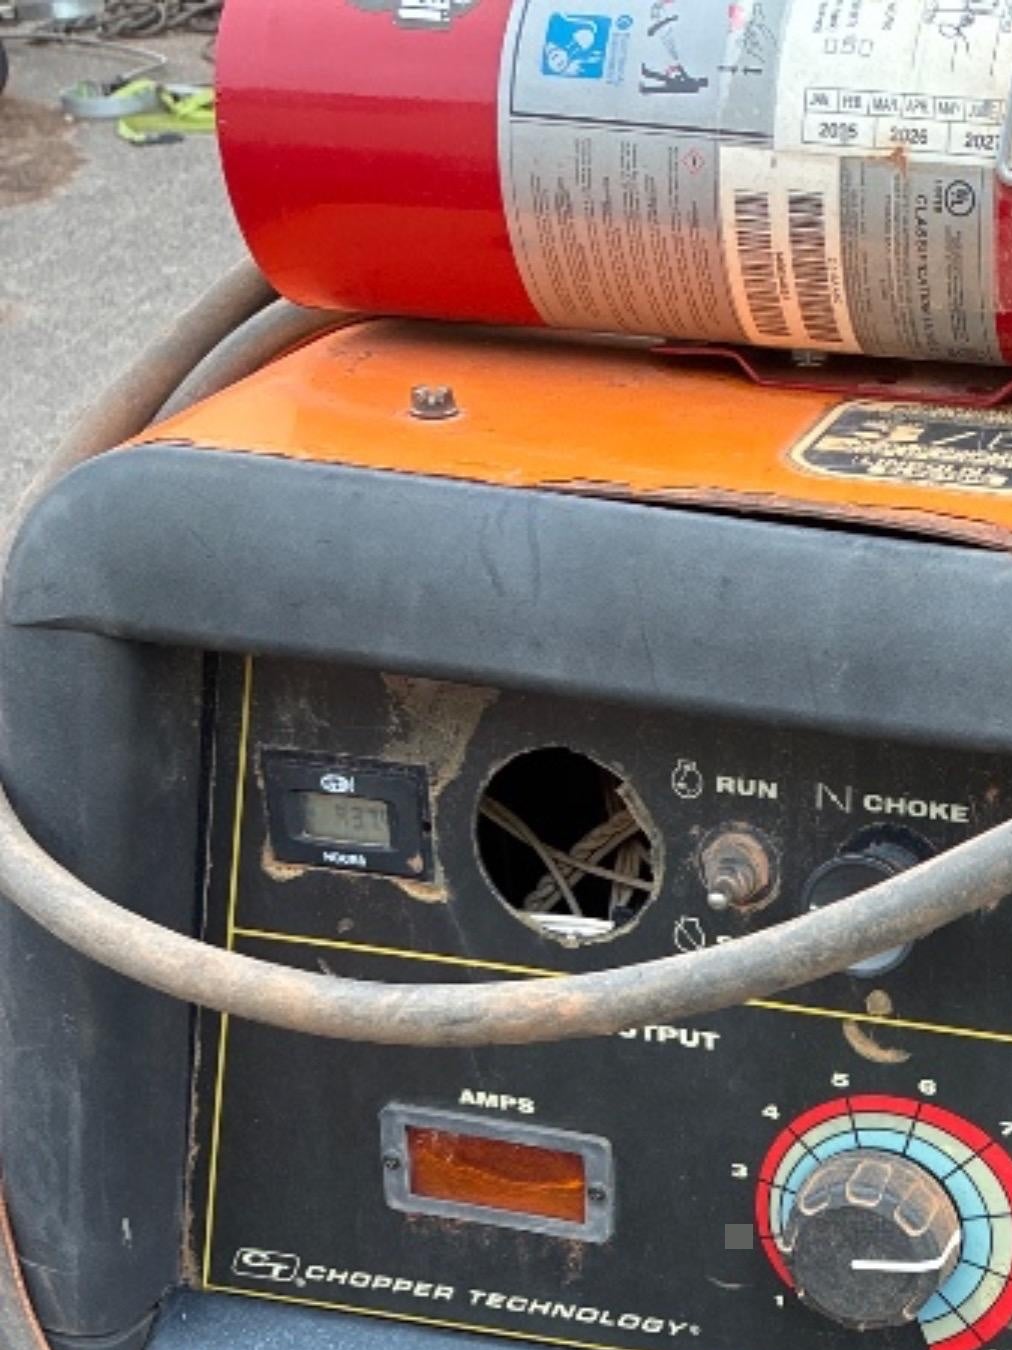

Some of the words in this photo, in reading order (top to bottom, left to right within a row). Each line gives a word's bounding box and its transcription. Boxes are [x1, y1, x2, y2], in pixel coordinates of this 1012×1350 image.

[842, 95, 862, 108] FEB
[873, 98, 898, 111] MAR
[905, 100, 929, 115] APR
[890, 127, 928, 144] 2026
[715, 774, 779, 799] RUN
[862, 793, 970, 824] CHOKE
[830, 1072, 850, 1088] 5
[918, 1079, 937, 1096] 6
[458, 1088, 536, 1115] AMPS
[761, 1104, 781, 1121] 4
[731, 1163, 749, 1179] 3
[304, 1264, 455, 1301] CHOPPER
[468, 1288, 688, 1336] TECHNOLOGY
[774, 1295, 785, 1308] 1
